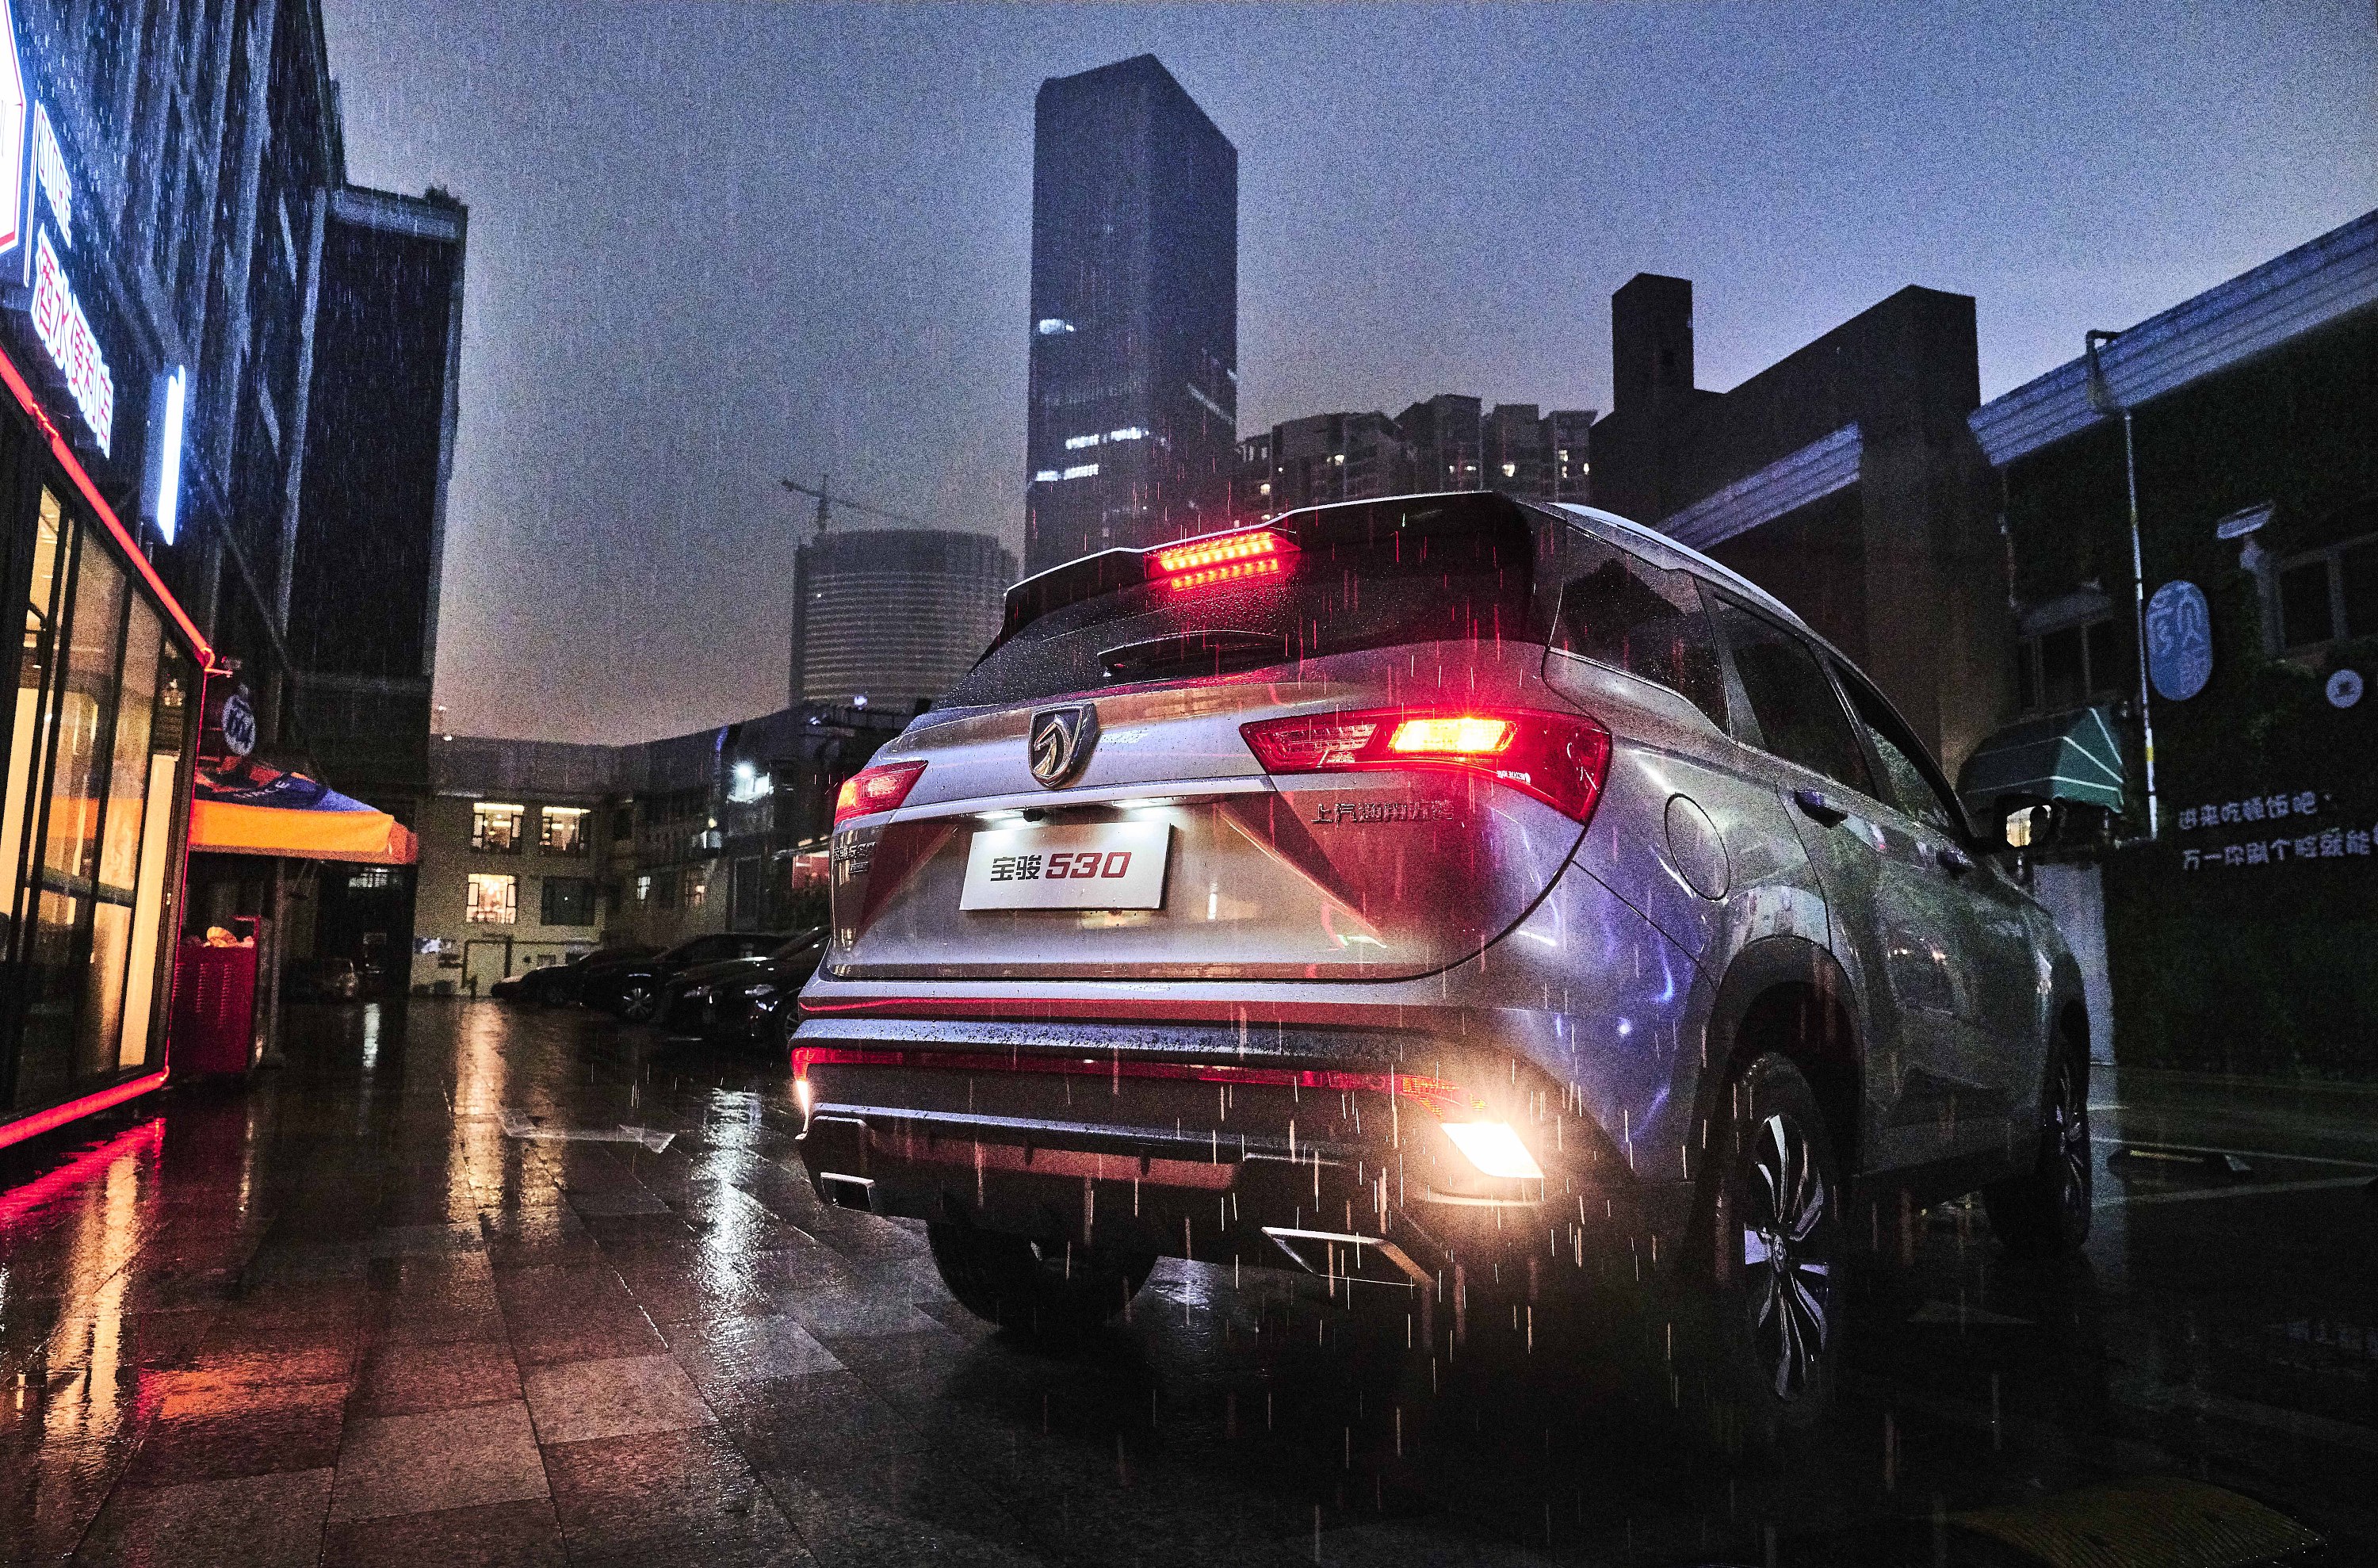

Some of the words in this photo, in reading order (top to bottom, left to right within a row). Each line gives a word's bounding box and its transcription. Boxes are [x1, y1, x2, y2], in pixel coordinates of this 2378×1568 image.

[38, 104, 72, 249] STORE
[30, 223, 114, 459] 酒水便利店
[1311, 799, 1455, 824] 上汽通用五菱
[990, 851, 1132, 882] 宝骏530
